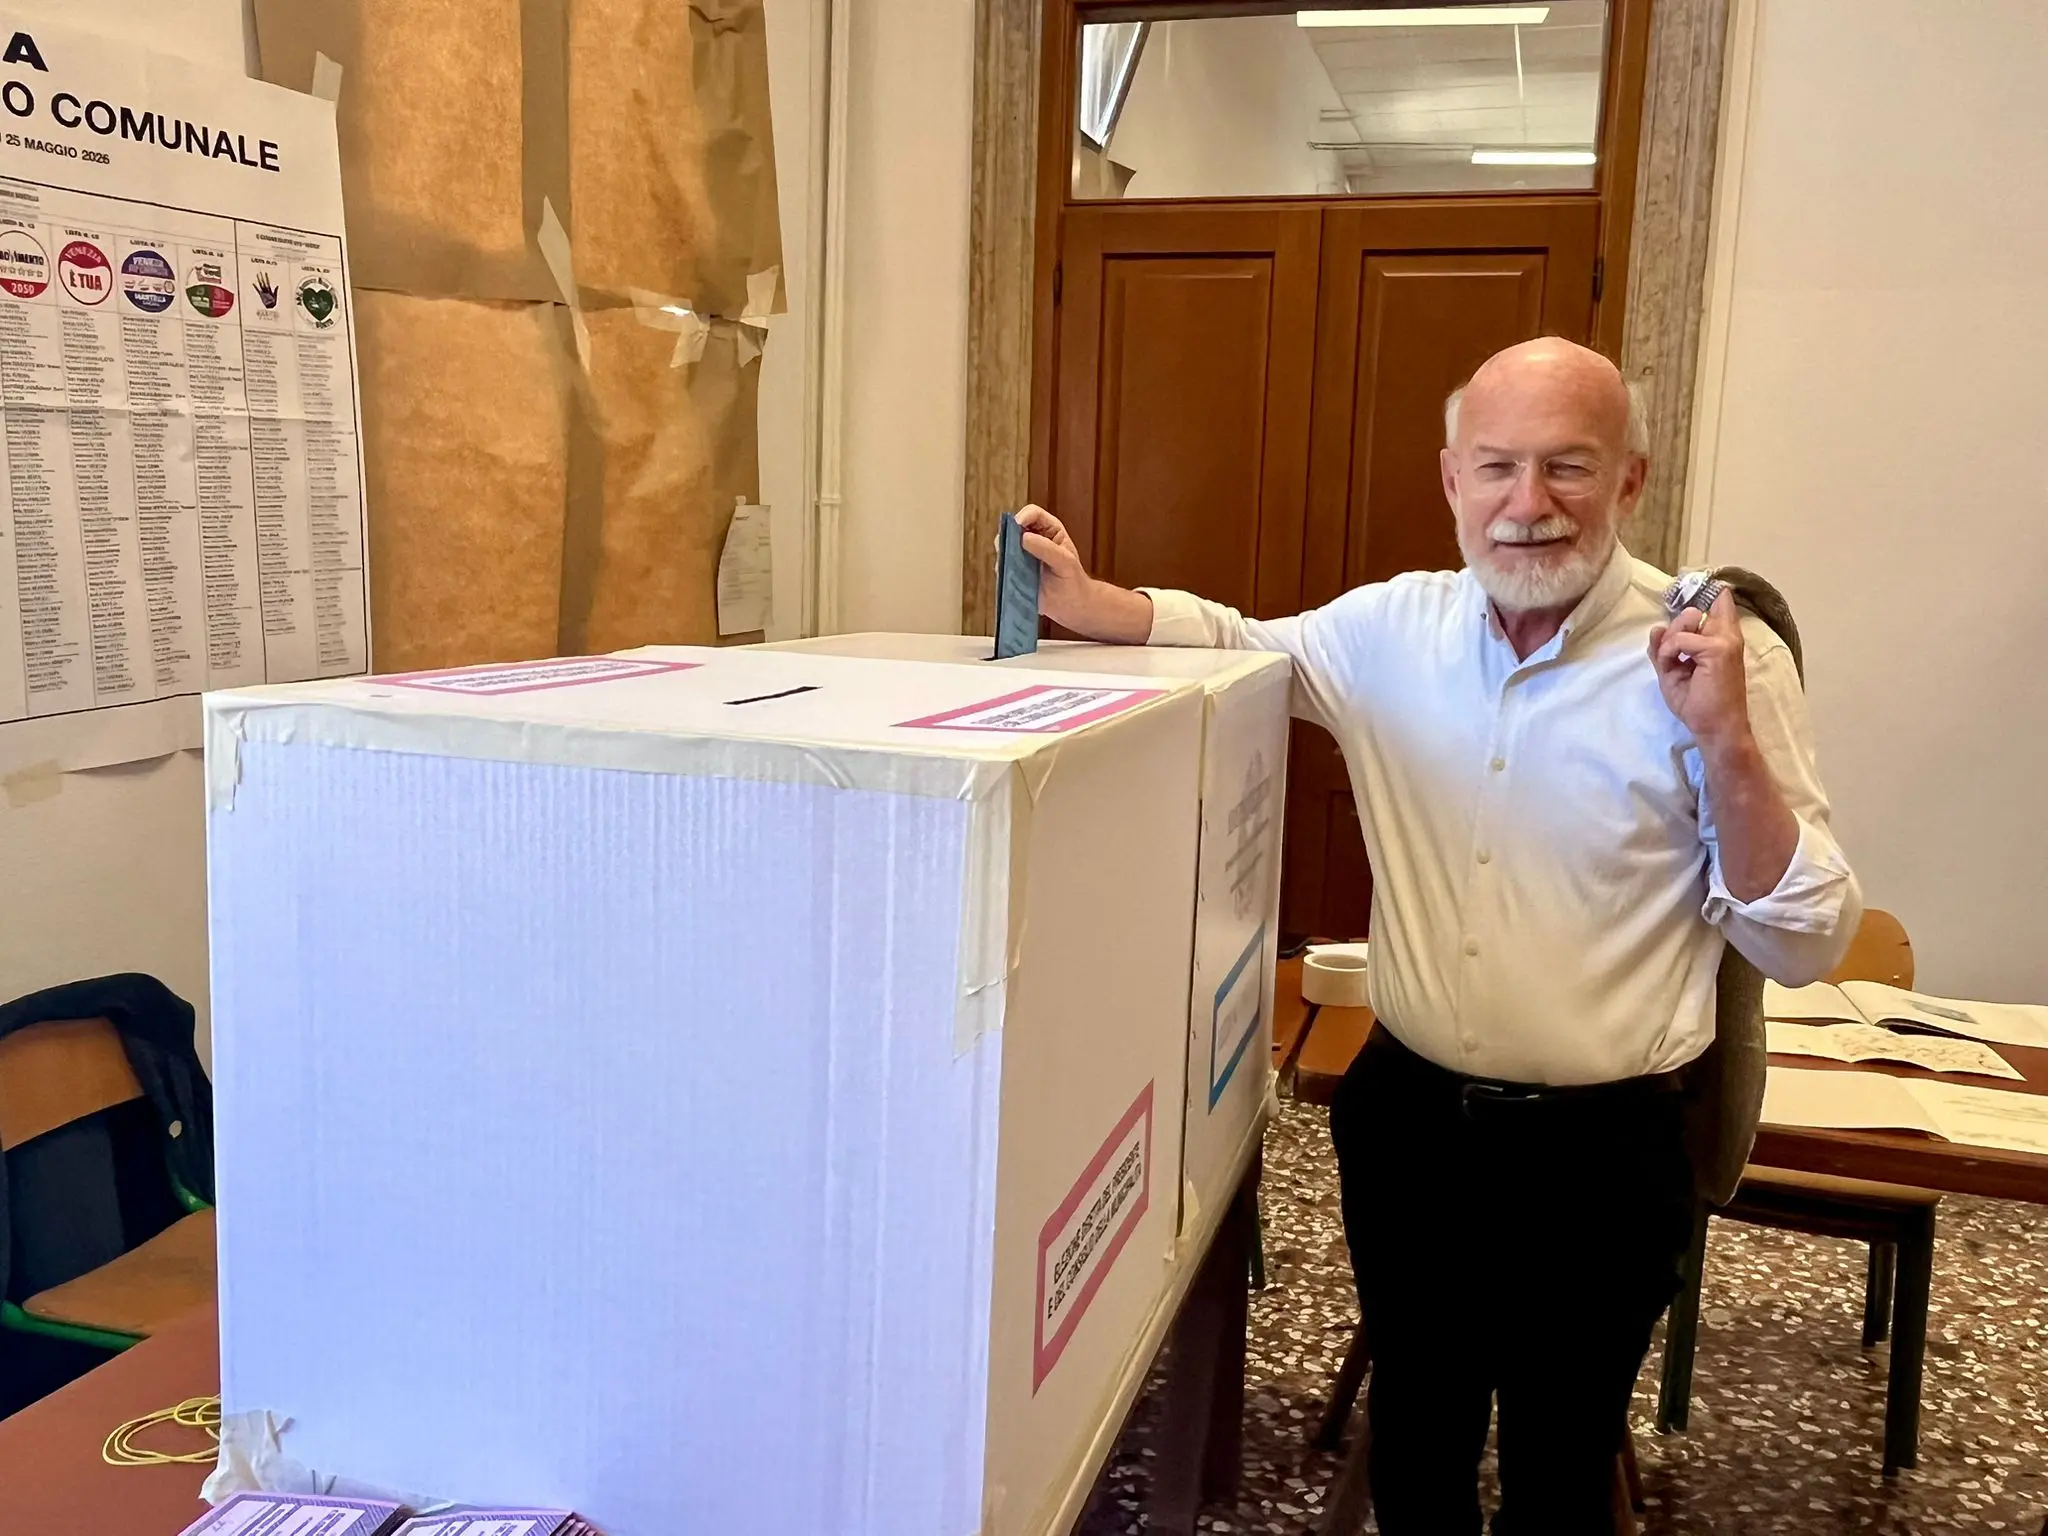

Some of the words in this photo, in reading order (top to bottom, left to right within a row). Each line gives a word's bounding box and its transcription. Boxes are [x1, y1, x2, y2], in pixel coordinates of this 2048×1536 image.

[3, 32, 49, 72] A
[2, 81, 35, 117] O
[51, 92, 280, 172] COMUNALE
[5, 134, 21, 147] 25
[24, 137, 78, 158] MAGGIO
[81, 149, 110, 165] 2026
[65, 246, 102, 264] VENEZIA
[11, 282, 35, 296] 2050
[78, 273, 103, 291] TUA
